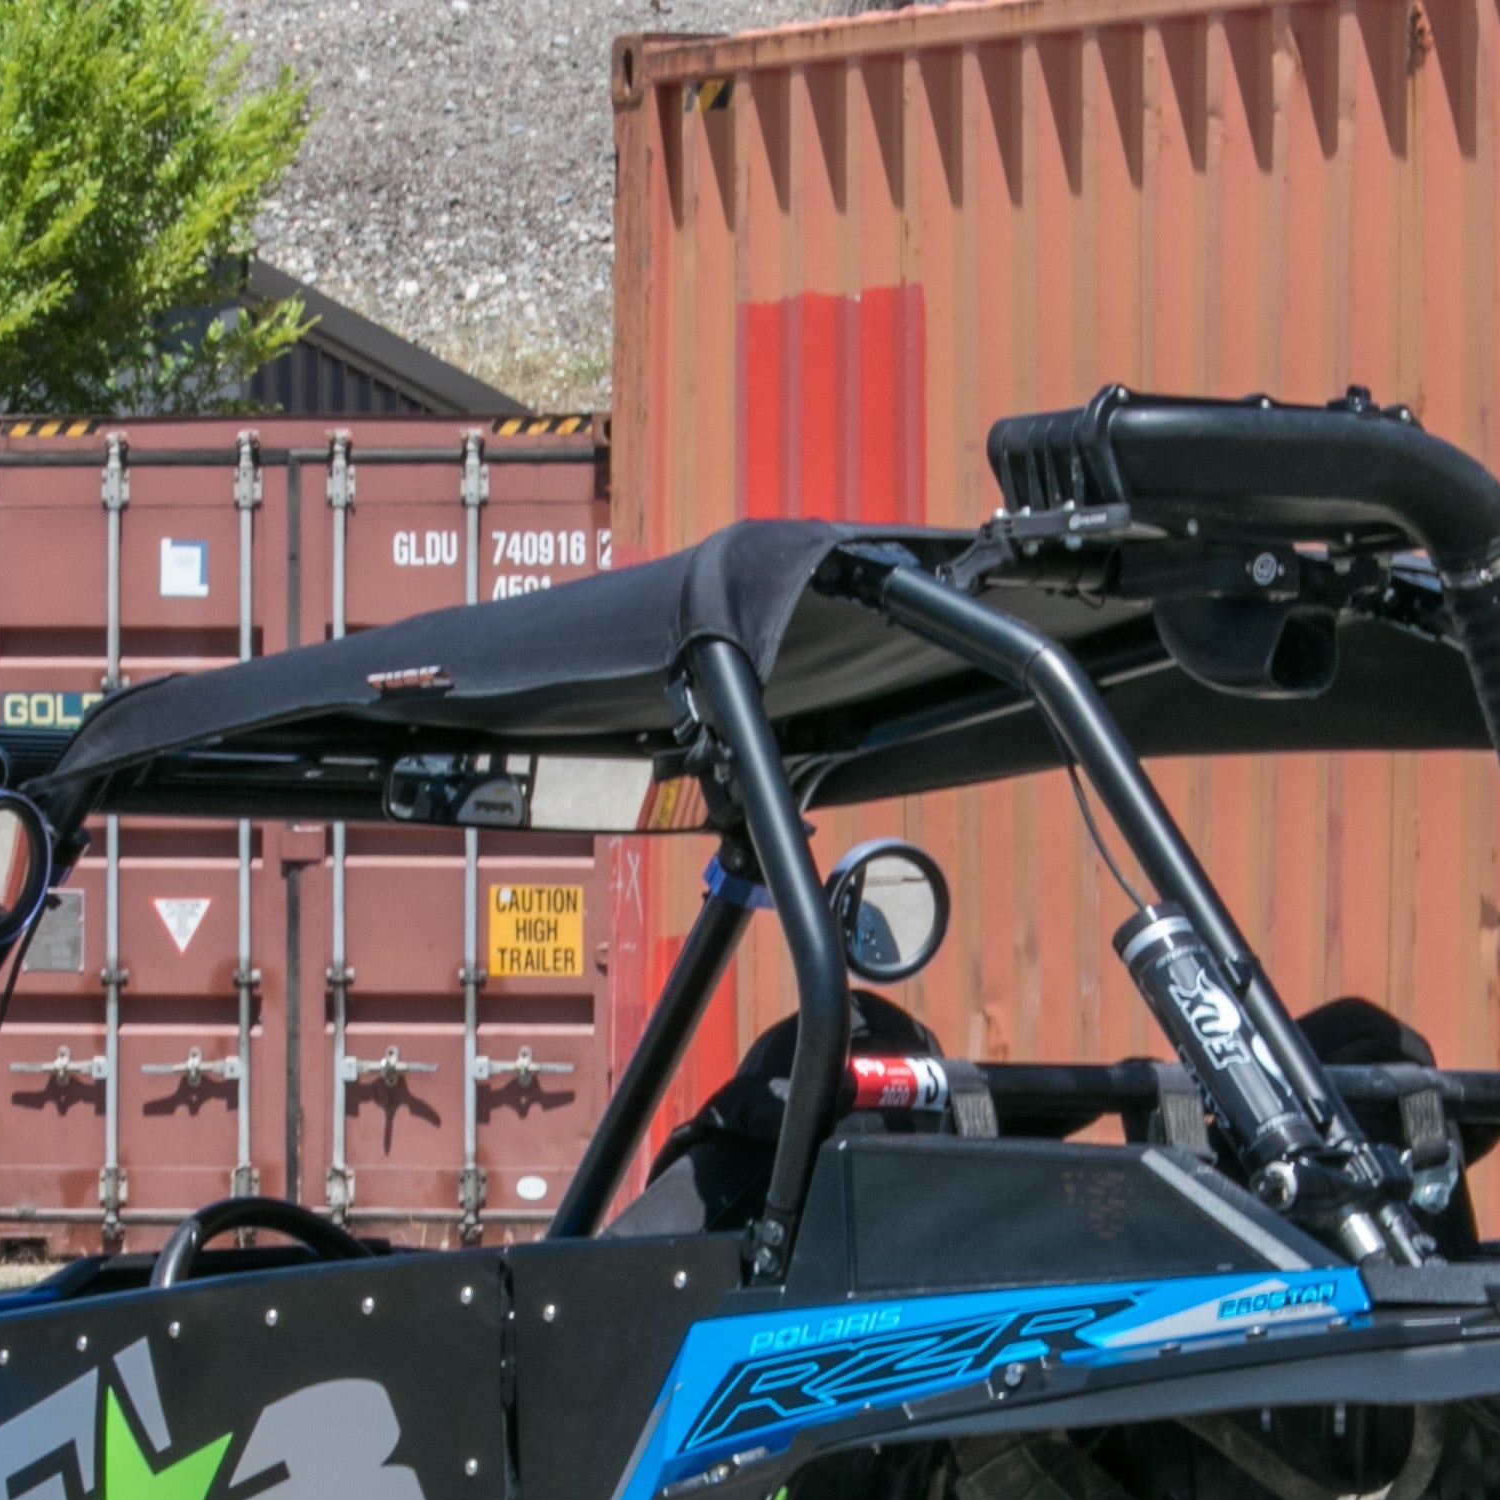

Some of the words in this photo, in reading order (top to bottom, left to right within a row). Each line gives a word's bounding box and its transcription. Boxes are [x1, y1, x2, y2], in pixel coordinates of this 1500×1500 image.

[393, 530, 458, 566] GLDU
[491, 530, 586, 566] 740916
[496, 888, 577, 913] CAUTION
[515, 918, 558, 942] HIGH
[498, 948, 576, 972] TRAILER
[1168, 968, 1252, 1071] FOX
[1217, 1281, 1338, 1321] PROSTAR
[748, 1305, 903, 1357] POLARIS
[683, 1297, 1141, 1452] RZR
